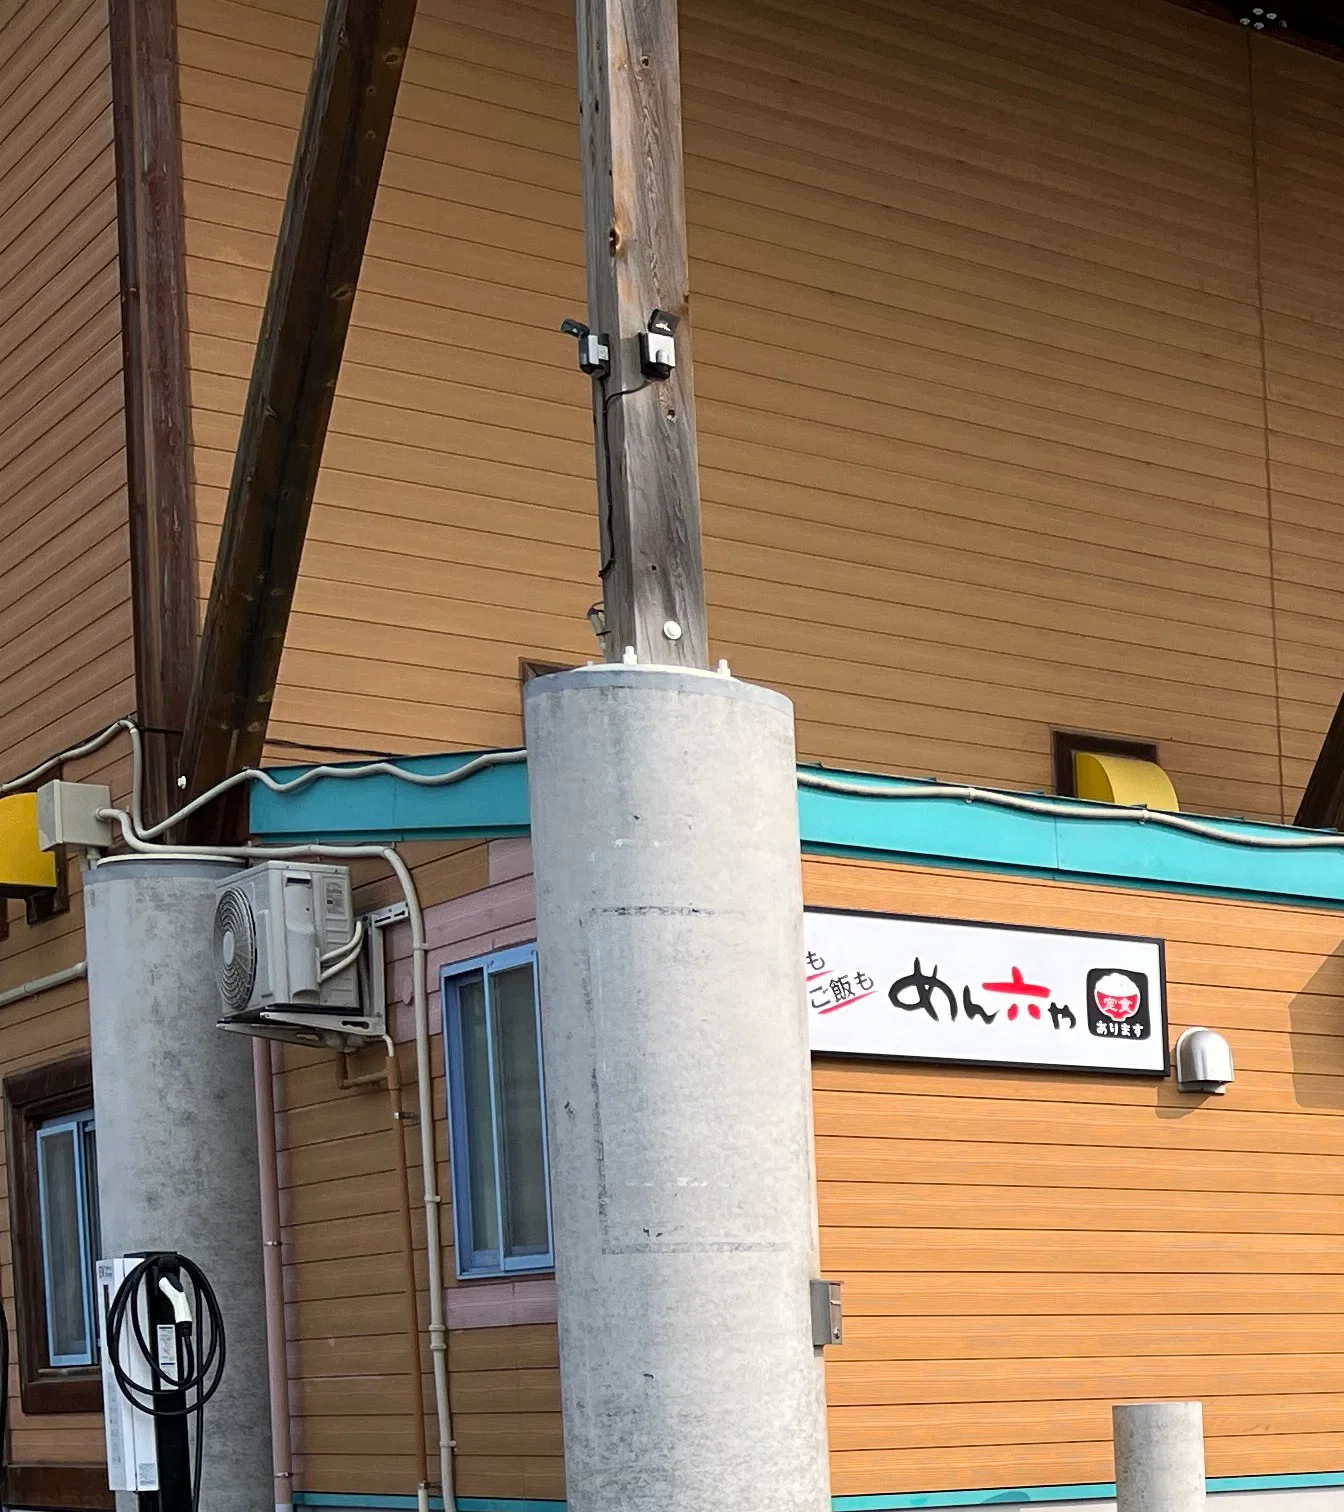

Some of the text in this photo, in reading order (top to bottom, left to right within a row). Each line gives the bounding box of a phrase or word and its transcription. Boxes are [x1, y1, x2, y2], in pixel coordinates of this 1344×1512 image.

[808, 970, 875, 1009] ご飯も
[887, 955, 1077, 1031] めん六や
[1095, 1019, 1144, 1038] あります
